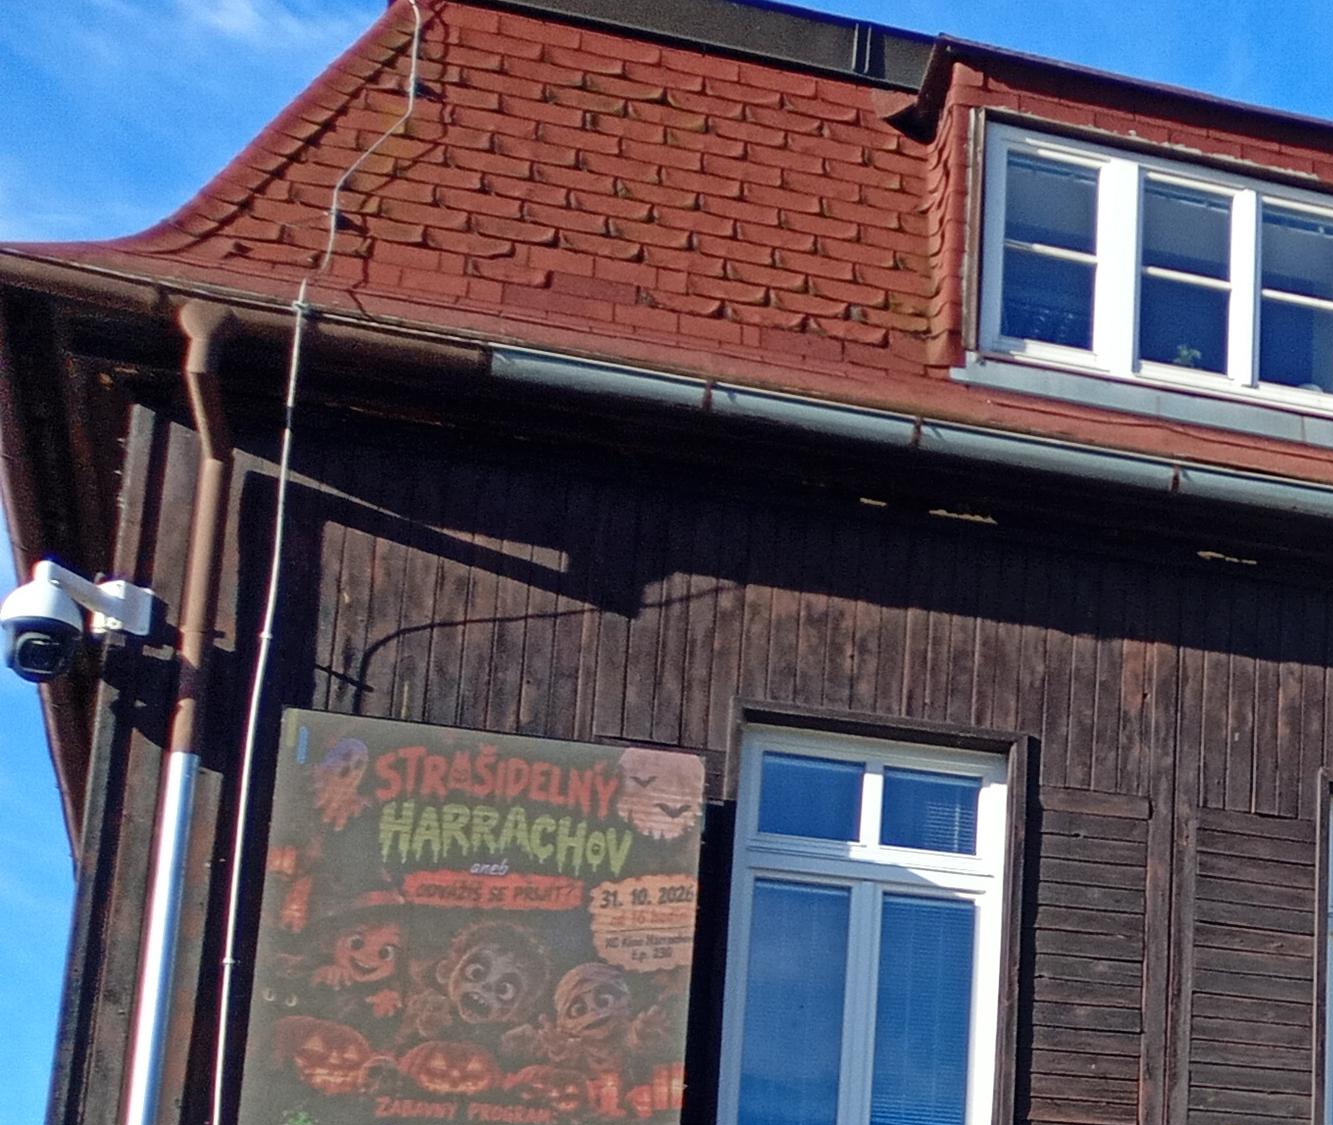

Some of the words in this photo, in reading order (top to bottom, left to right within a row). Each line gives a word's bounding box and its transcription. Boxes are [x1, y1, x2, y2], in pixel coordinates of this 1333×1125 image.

[375, 744, 619, 820] STRAŠIDELNÝ
[378, 799, 633, 877] HARRACHOV
[470, 858, 509, 876] aneb
[488, 886, 508, 902] SE
[600, 889, 623, 909] 31.
[631, 887, 652, 906] 10.
